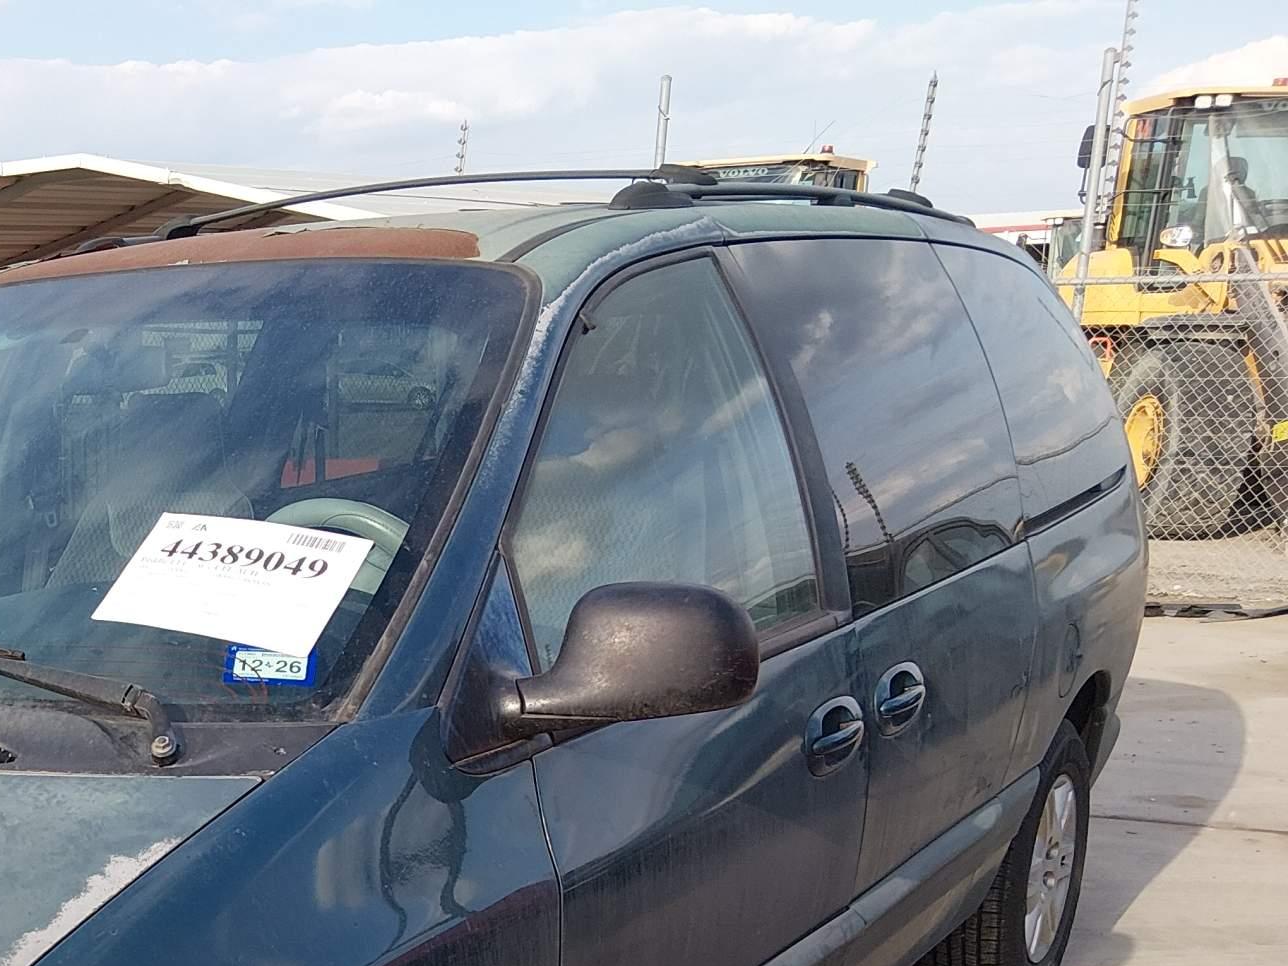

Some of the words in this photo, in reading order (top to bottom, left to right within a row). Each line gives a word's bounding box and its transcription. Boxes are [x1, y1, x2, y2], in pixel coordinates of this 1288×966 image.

[719, 166, 769, 178] VOLVO
[160, 538, 329, 579] 44389049
[275, 660, 302, 674] 26
